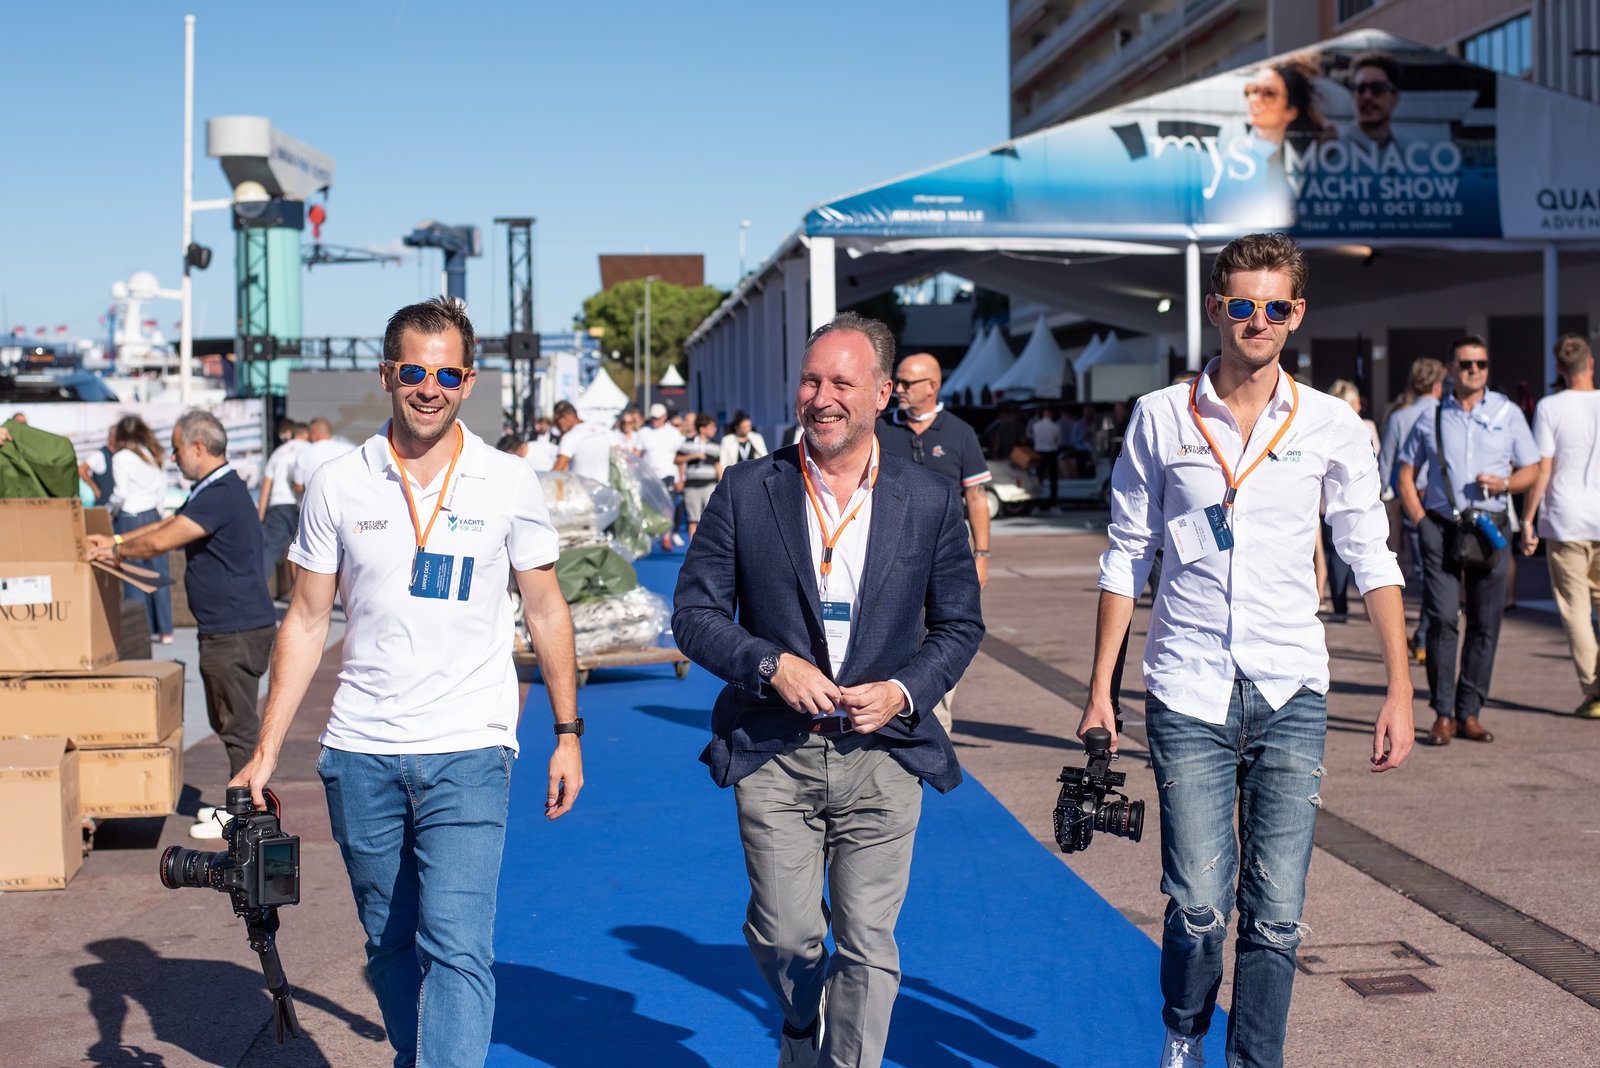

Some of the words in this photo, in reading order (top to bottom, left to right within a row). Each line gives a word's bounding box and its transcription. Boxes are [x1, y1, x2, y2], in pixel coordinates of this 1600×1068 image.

[1147, 135, 1256, 199] mys
[1284, 140, 1462, 174] MONACO
[1286, 175, 1372, 199] YACHT
[1379, 176, 1460, 199] SHOW
[1313, 202, 1343, 216] SEP
[1383, 202, 1415, 216] OCT
[1421, 202, 1464, 216] 2022
[1537, 188, 1600, 210] QUA
[357, 519, 389, 527] NORTHROP
[360, 525, 387, 533] JOHNSON
